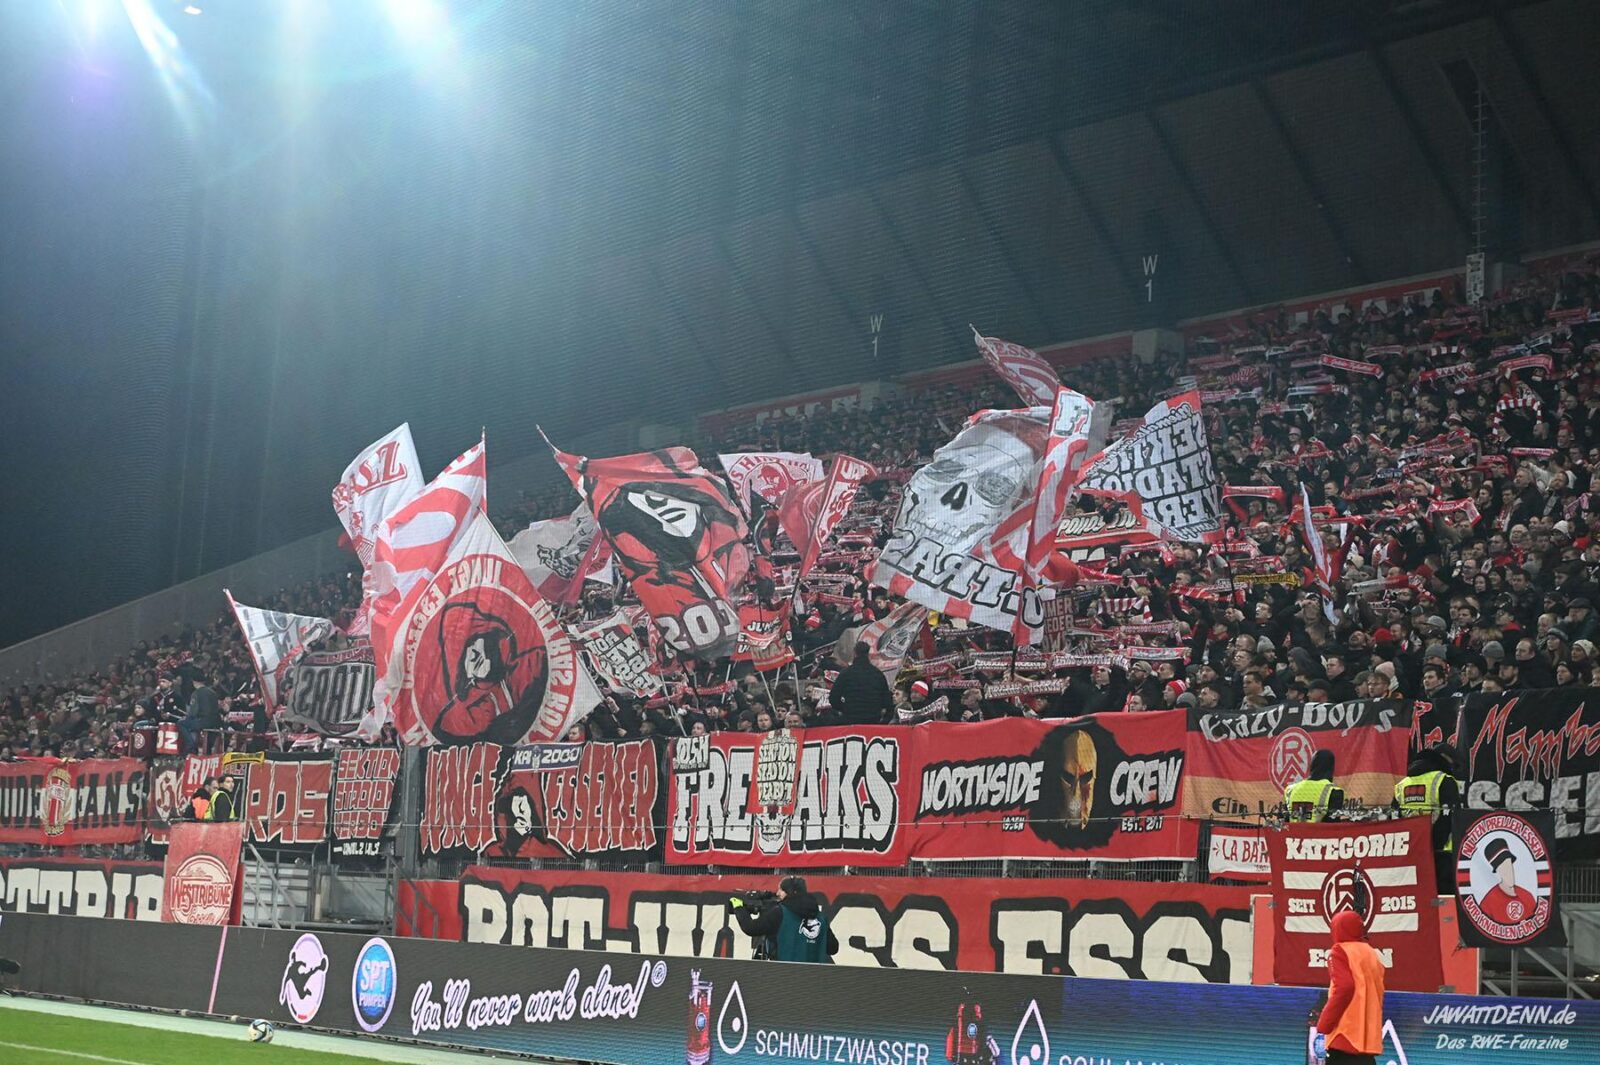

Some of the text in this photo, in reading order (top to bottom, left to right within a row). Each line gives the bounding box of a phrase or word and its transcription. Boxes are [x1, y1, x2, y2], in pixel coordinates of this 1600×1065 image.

[1142, 255, 1158, 276] W
[1144, 279, 1153, 302] 1
[870, 313, 884, 333] W
[337, 748, 400, 779] SEKTION
[541, 747, 580, 765] 2000
[421, 741, 504, 855] JUNGE
[540, 738, 657, 853] ESSENER
[673, 735, 899, 853] FREAKS
[919, 756, 1184, 814] NORTHSIDE CREW
[1212, 796, 1248, 815] Ein
[1222, 838, 1239, 862] LA
[1285, 831, 1410, 861] KATEGORIE
[1461, 815, 1545, 860] NUTTEN PRELLER ESSEN
[170, 876, 232, 916] WESTTRIBÜNE
[1288, 895, 1416, 913] SEIT 2015
[1463, 894, 1482, 922] WIR
[1477, 914, 1519, 940] KNALLEN
[1517, 918, 1538, 939] FÜR
[1308, 948, 1394, 969] ESN
[360, 959, 390, 991] SPT
[411, 977, 471, 1036] You'll
[466, 991, 523, 1031] never
[524, 968, 580, 1024] work
[754, 1028, 930, 1065] SCHMUTZWASSER
